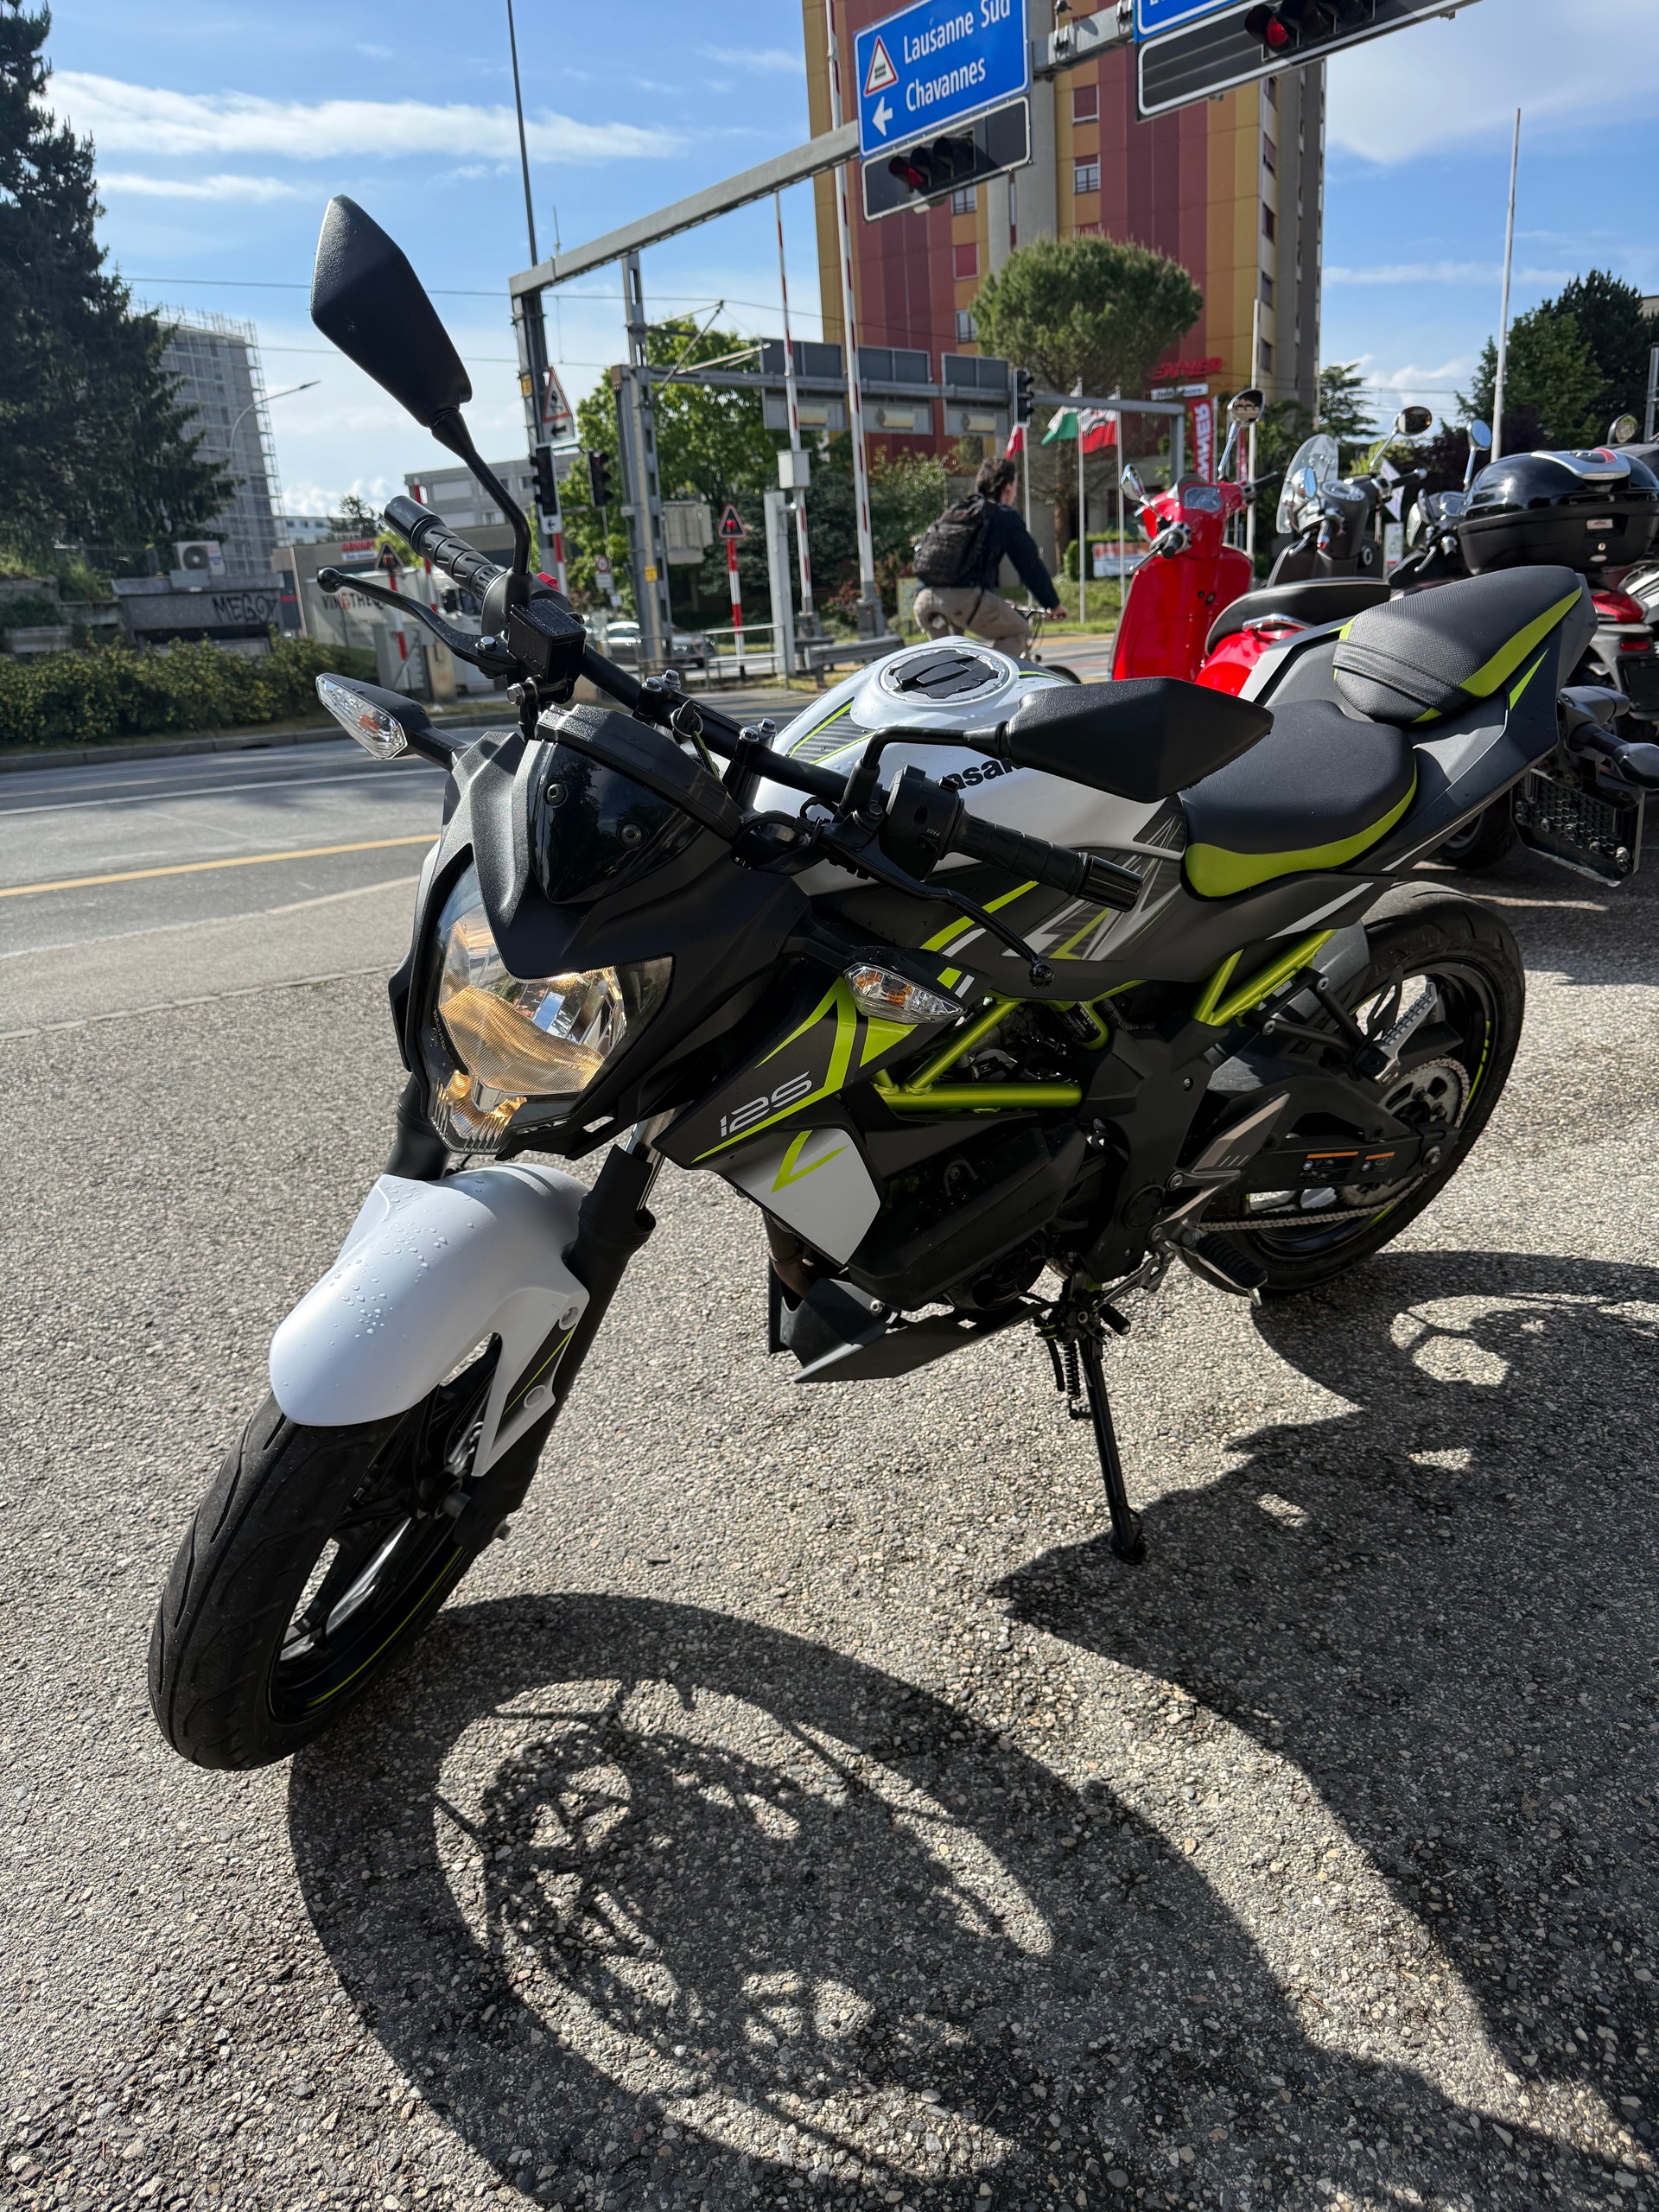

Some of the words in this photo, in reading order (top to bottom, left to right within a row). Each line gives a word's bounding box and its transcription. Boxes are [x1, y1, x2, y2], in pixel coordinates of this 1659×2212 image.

[904, 11, 973, 64] Lausanne
[981, 0, 1010, 28] Sud
[906, 58, 986, 111] Chavannes
[946, 758, 1024, 790] asak
[720, 1071, 812, 1137] 125
